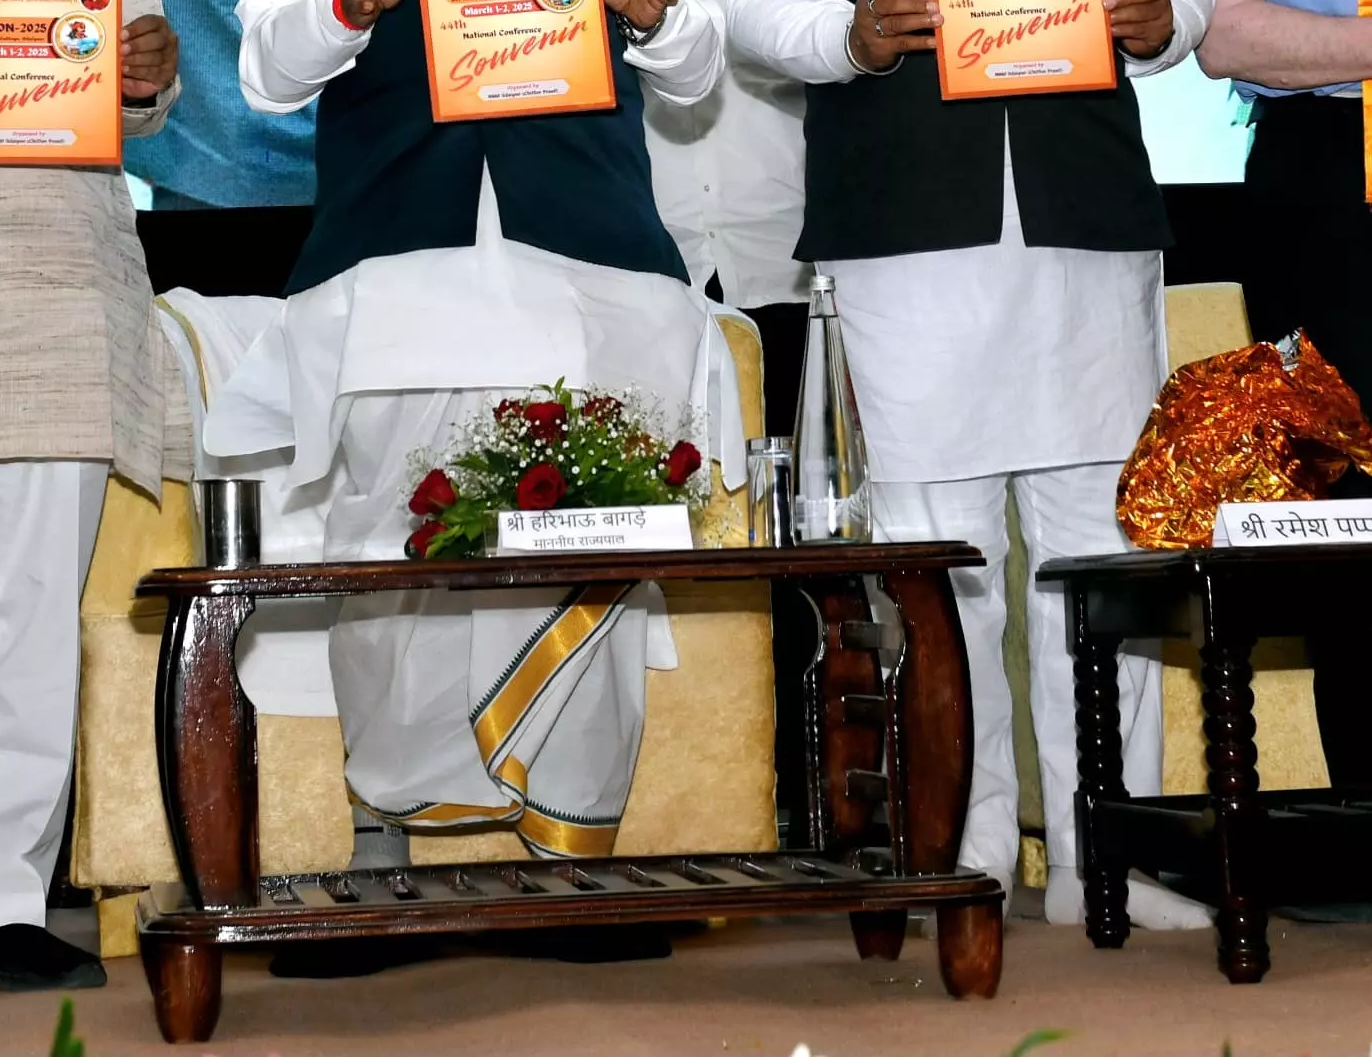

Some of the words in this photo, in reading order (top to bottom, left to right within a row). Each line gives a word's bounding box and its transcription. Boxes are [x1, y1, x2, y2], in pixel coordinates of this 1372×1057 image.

[464, 6, 493, 16] March
[512, 2, 533, 12] 2025
[970, 9, 1004, 19] National
[1005, 7, 1046, 17] Conference
[463, 29, 497, 40] National
[499, 26, 542, 38] Conference
[27, 48, 49, 56] 2025
[448, 16, 588, 92] Souvenir
[10, 73, 55, 81] Conference
[507, 510, 525, 532] श्री
[529, 509, 596, 532] हरिभाऊ
[601, 507, 646, 529] बागड़े
[1241, 513, 1266, 539] श्री
[1271, 511, 1329, 538] रमेश
[578, 534, 625, 547] राज्यपाल
